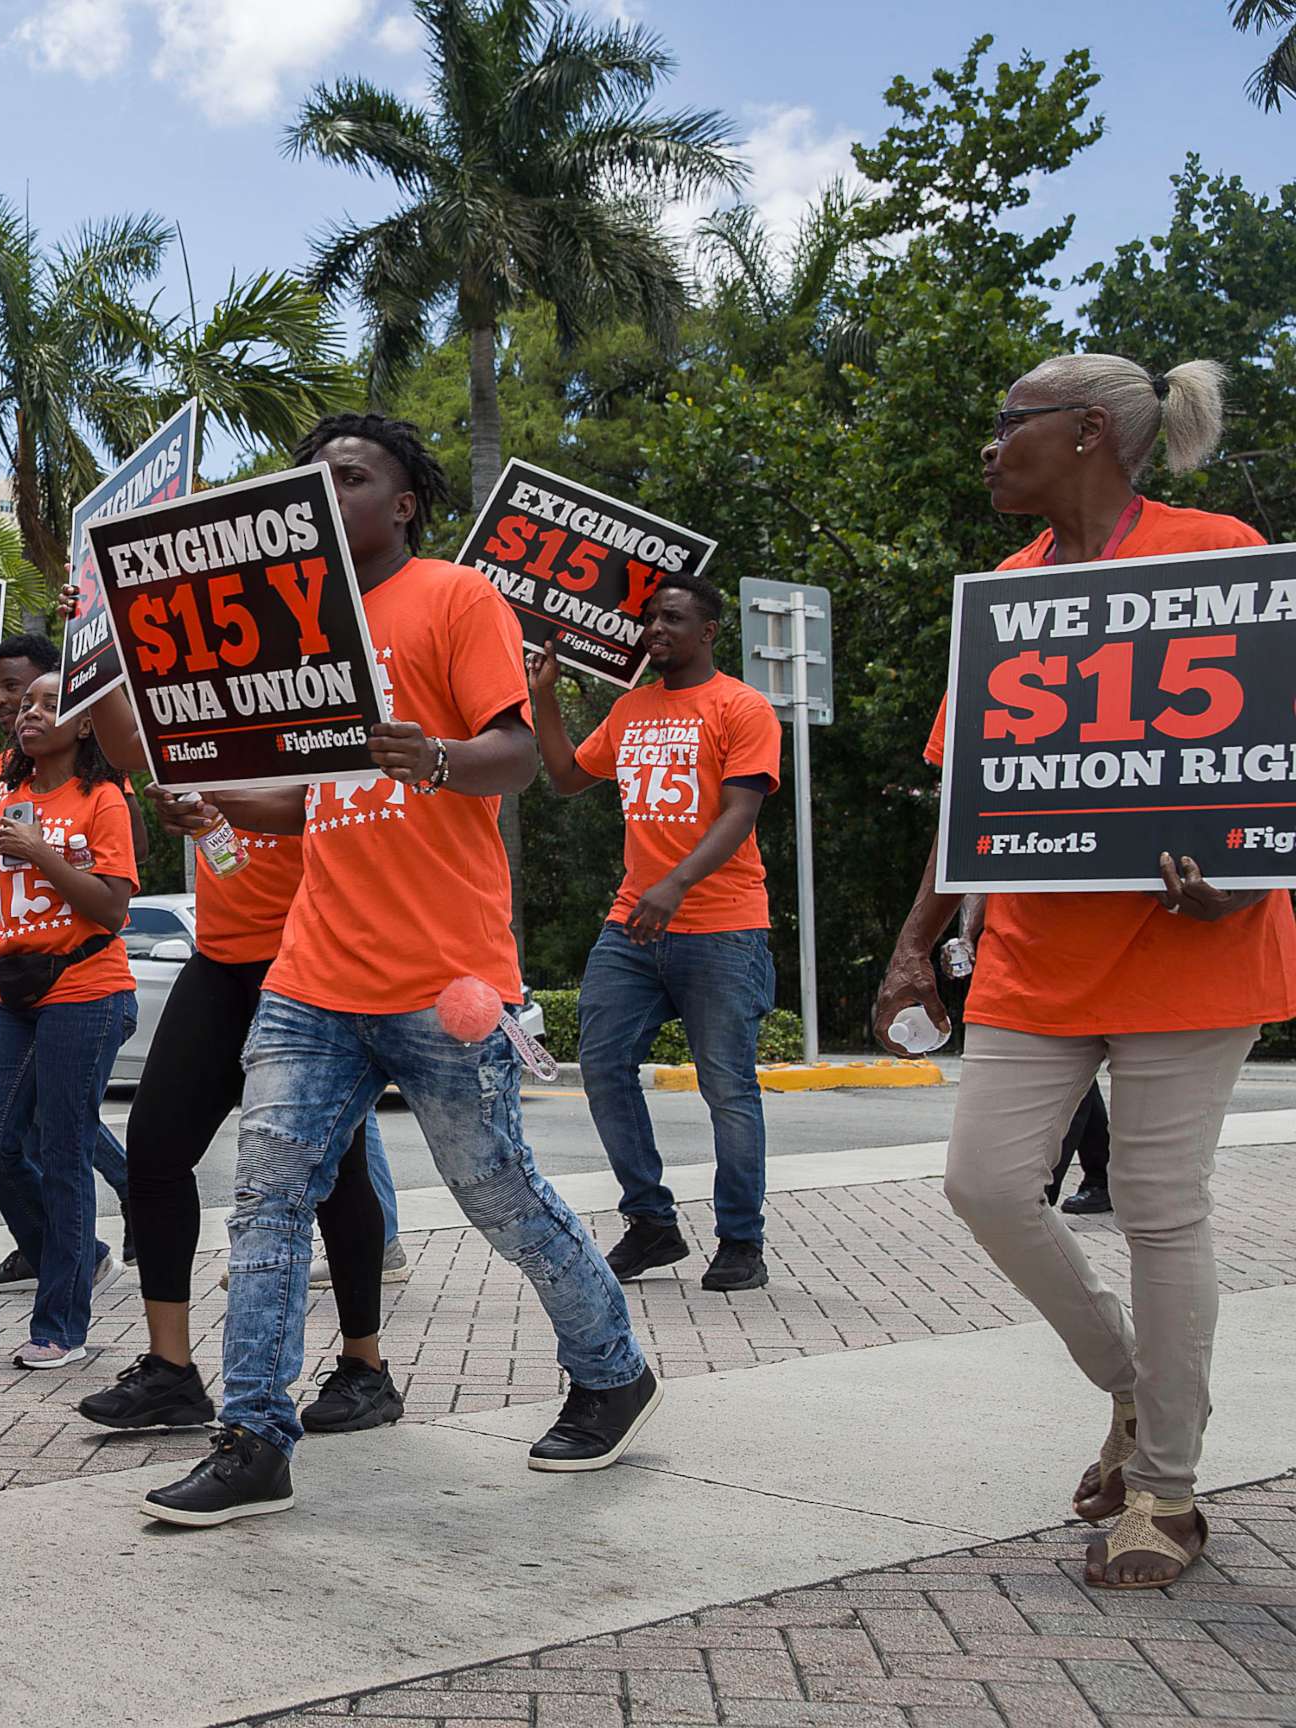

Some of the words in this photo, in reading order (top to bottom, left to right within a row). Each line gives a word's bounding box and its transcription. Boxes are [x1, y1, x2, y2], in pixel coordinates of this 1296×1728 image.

[108, 501, 320, 588] EXIGIMOS
[507, 480, 690, 573] EXIGIMOS
[484, 514, 608, 593] $15
[618, 559, 664, 618] Y
[128, 573, 261, 677] $15
[265, 556, 329, 657] Y
[474, 559, 534, 605] UNA
[543, 587, 644, 647] UNIÓN
[989, 596, 1090, 642] WE
[71, 611, 108, 662] UNA
[557, 631, 628, 667] #FightFor15
[146, 679, 227, 726] UNA
[227, 655, 357, 717] UNIÓN
[983, 634, 1245, 745] $15
[162, 741, 218, 763] #FLfor15
[276, 725, 367, 756] #FightFor15
[616, 744, 691, 766] FIGHT
[689, 745, 699, 766] FOR
[621, 727, 699, 744] FLORIDA
[981, 750, 1165, 792] UNION
[976, 832, 1098, 856] #FLfor15
[1226, 826, 1296, 853] #Fig
